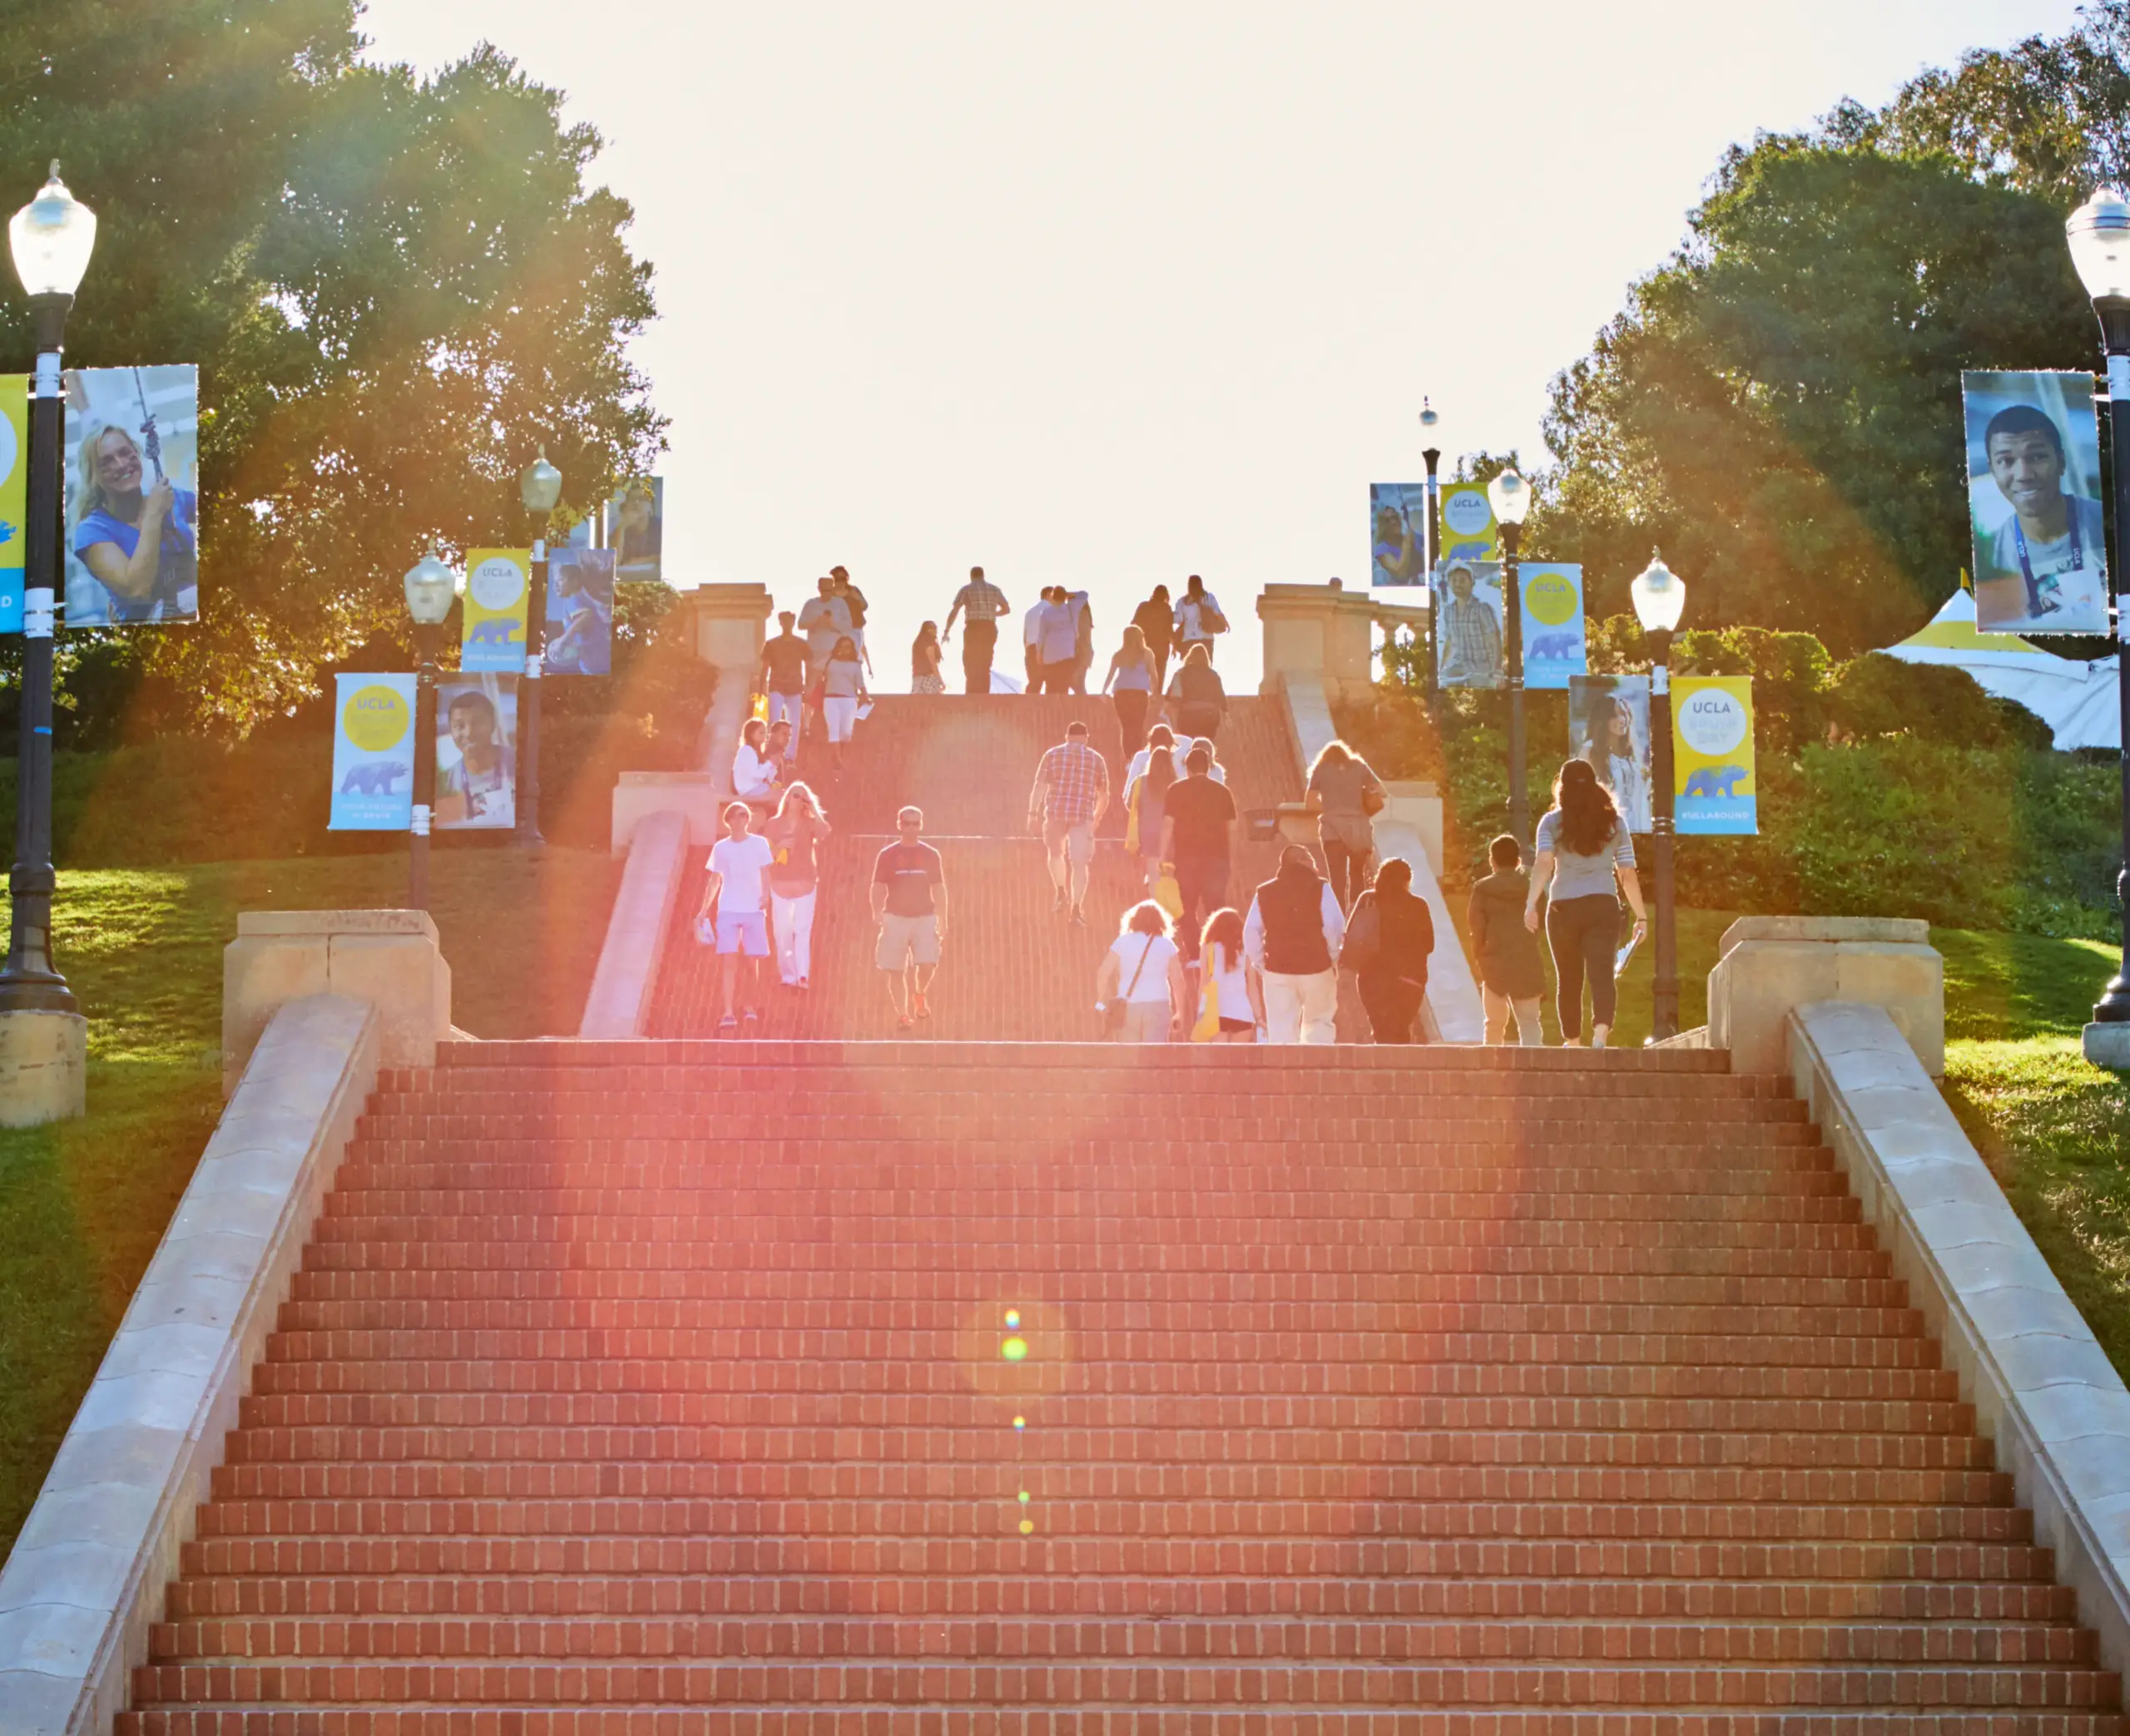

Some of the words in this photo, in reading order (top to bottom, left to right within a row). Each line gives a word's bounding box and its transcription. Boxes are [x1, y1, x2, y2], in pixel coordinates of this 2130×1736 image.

[1454, 498, 1481, 507] UCLA
[483, 567, 513, 577] UCLA
[1536, 582, 1566, 592] UCLA
[357, 697, 395, 710] UCLA
[1693, 701, 1731, 714] UCLA
